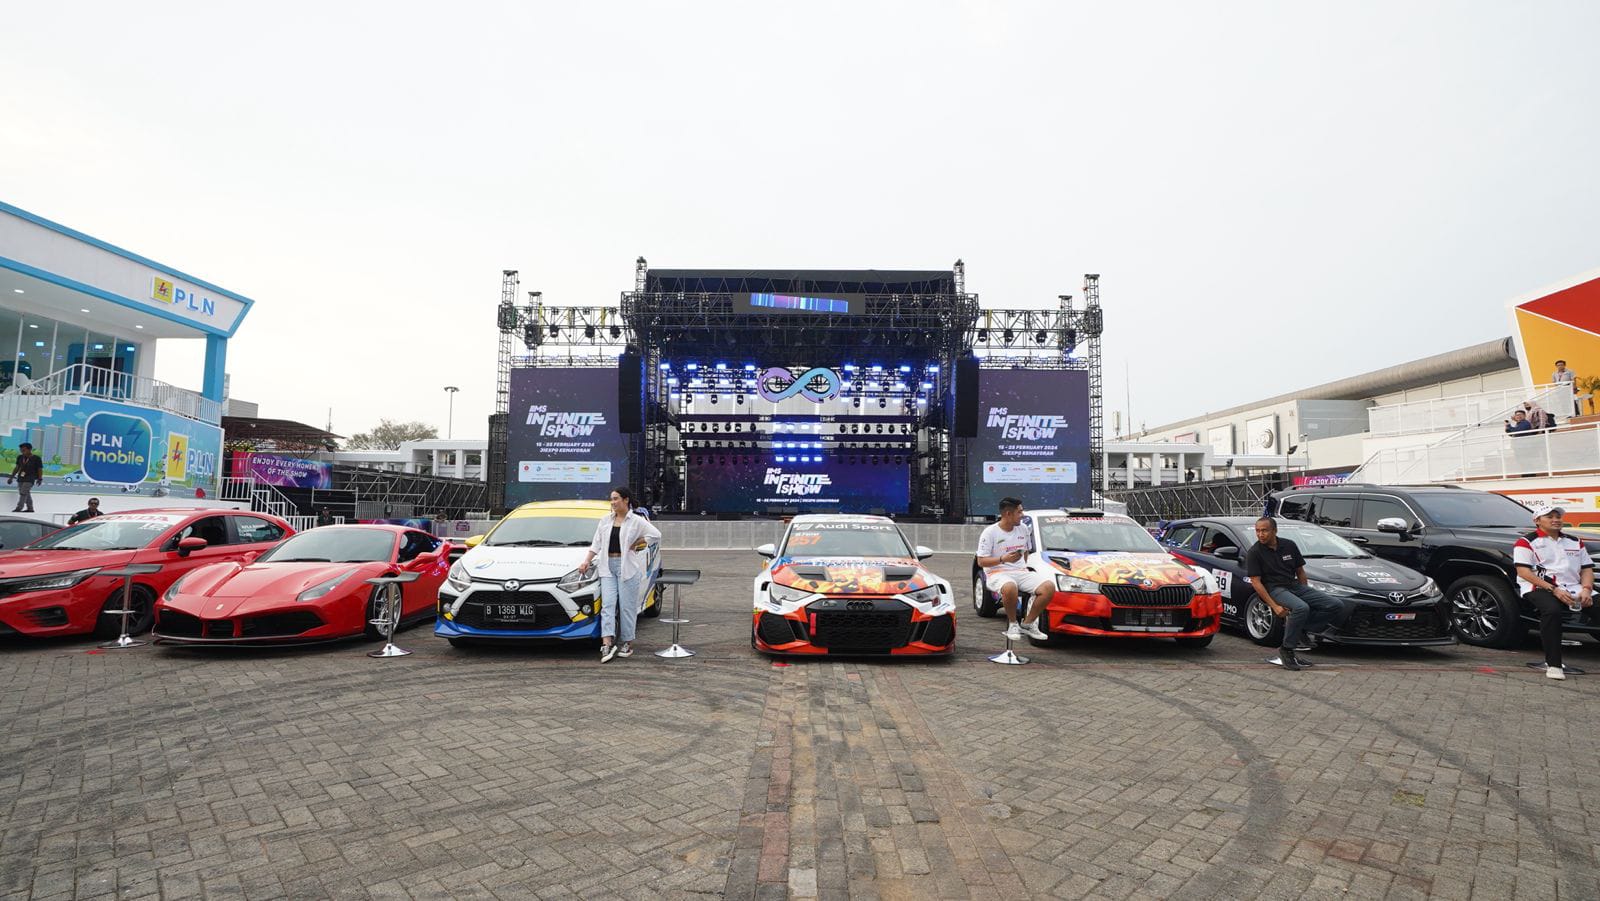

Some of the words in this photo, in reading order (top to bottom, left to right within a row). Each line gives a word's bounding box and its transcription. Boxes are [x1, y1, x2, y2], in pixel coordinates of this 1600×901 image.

[174, 287, 214, 315] PLN
[526, 412, 606, 431] INFINITE
[987, 415, 1069, 433] INFINITE
[546, 424, 594, 437] SHOW
[1008, 427, 1057, 440] SHOW
[91, 432, 123, 448] PLN
[90, 449, 145, 465] mobile
[187, 448, 214, 476] PLN
[252, 457, 276, 465] ENJOY
[290, 470, 308, 478] SHOW
[763, 473, 832, 490] INFINITE
[781, 484, 822, 495] SHOW
[486, 605, 492, 615] B
[498, 605, 516, 615] 1369
